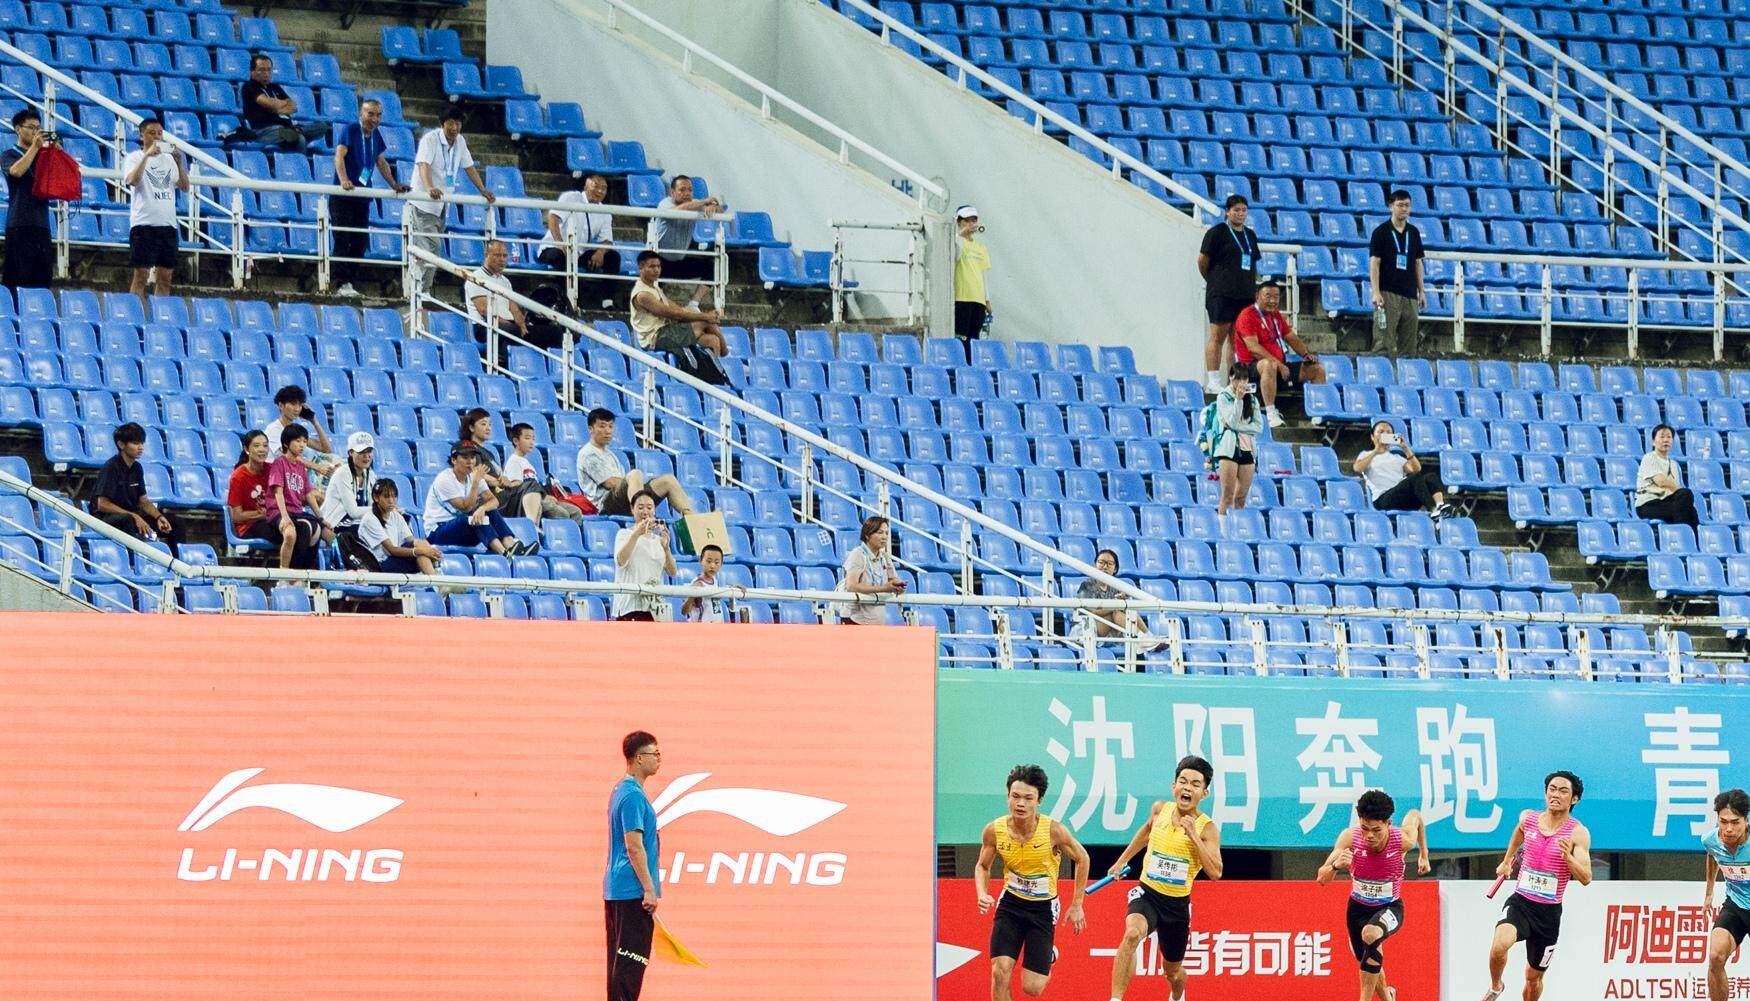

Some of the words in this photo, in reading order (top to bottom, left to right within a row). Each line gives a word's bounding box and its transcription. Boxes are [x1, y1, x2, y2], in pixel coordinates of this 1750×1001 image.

[1046, 696, 1502, 834] 沈阳奔跑
[177, 847, 404, 883] LI-NING
[658, 851, 848, 886] I-NING
[1604, 904, 1741, 964] 阿迪雷
[1604, 978, 1688, 999] ADLTSN
